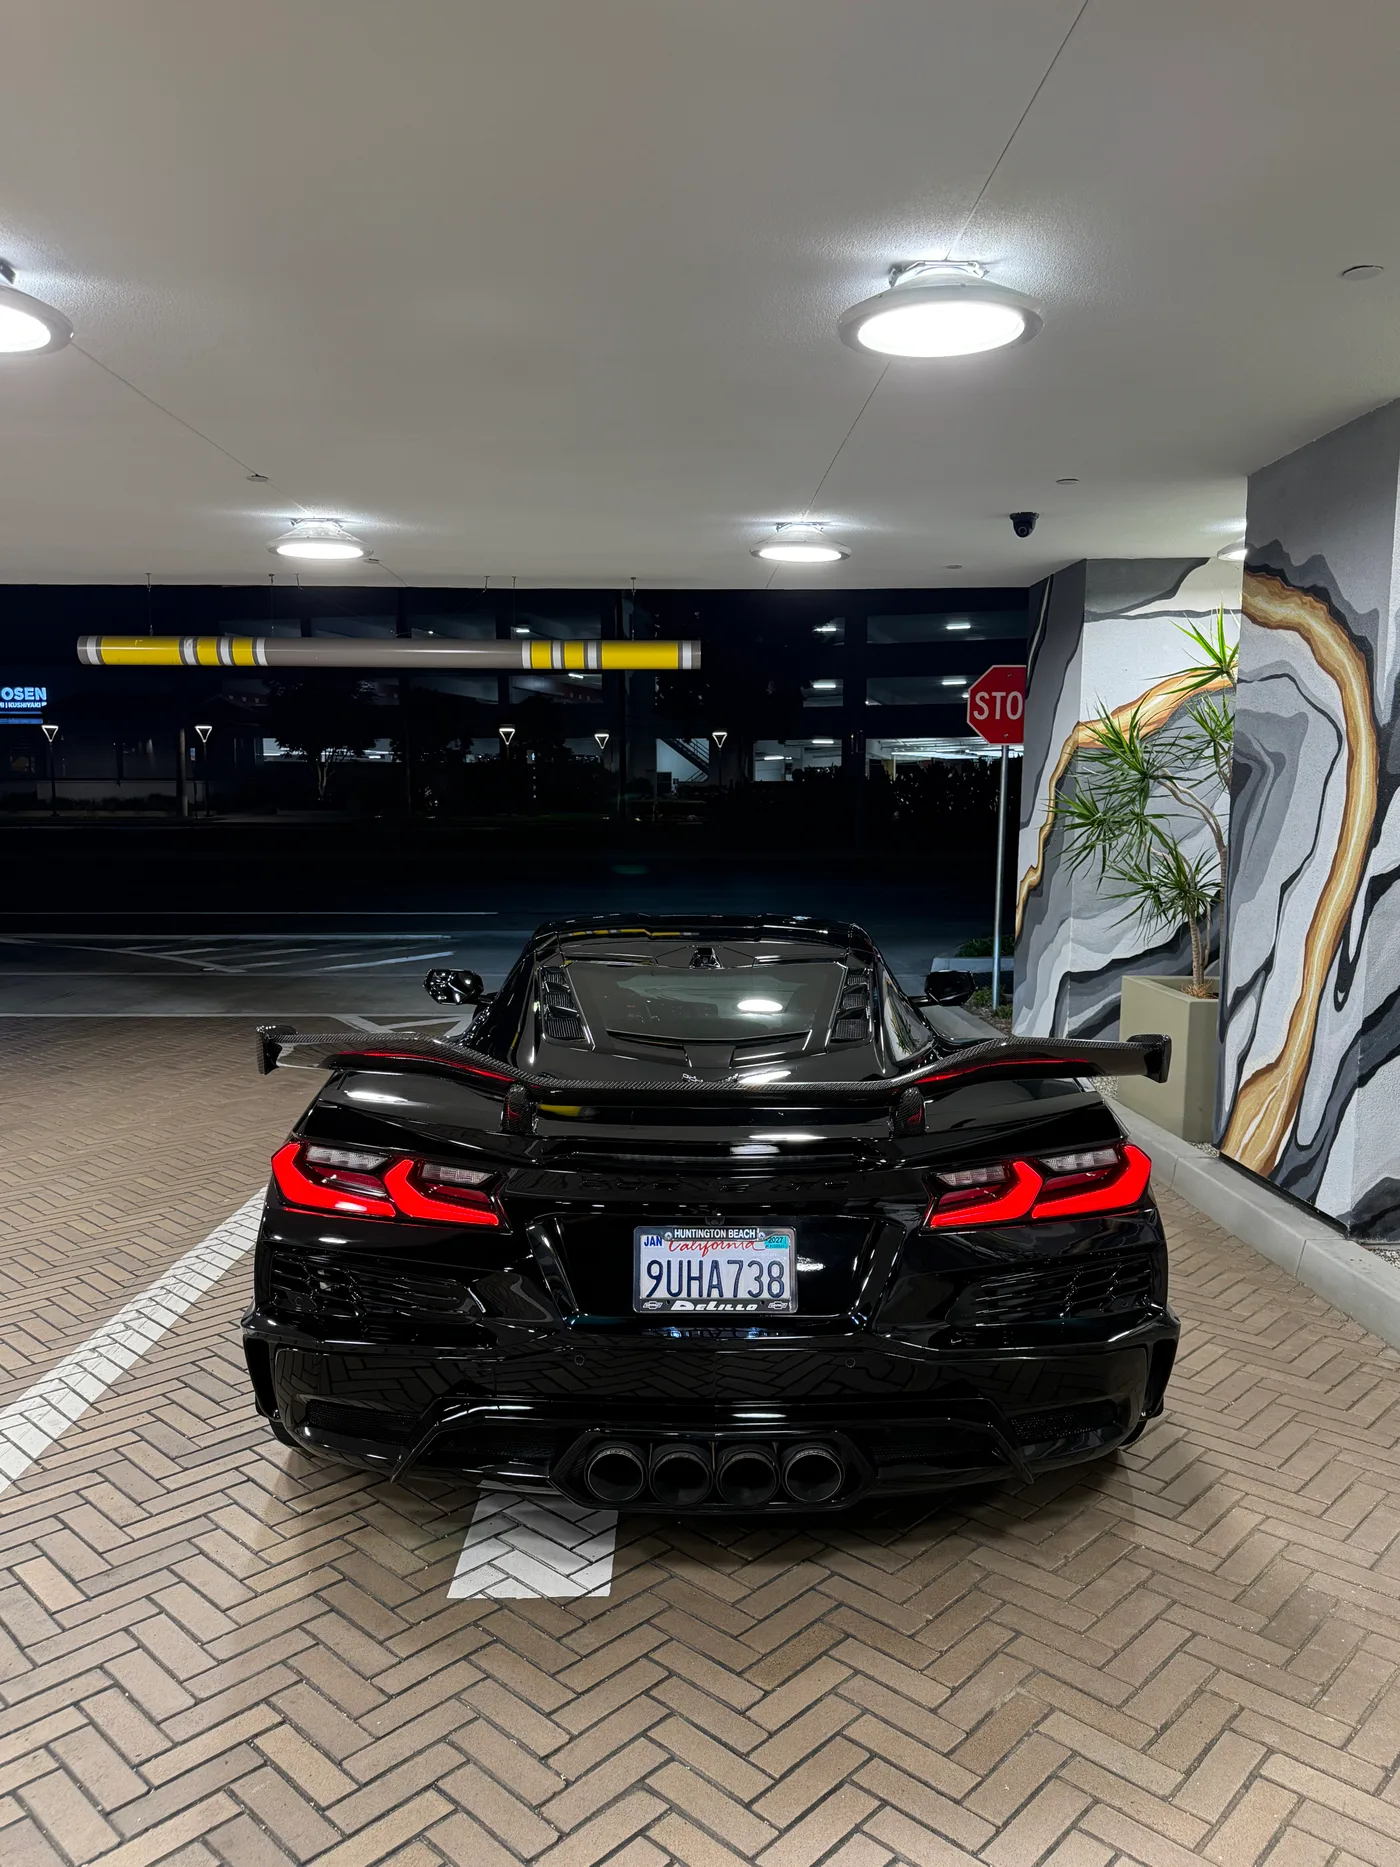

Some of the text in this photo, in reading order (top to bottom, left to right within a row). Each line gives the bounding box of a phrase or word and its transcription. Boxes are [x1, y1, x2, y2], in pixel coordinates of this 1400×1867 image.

[1, 687, 47, 701] OSEN
[973, 691, 1024, 721] STO
[674, 1229, 756, 1239] HUNTINGTON BEACH
[768, 1236, 784, 1244] 2027
[644, 1236, 663, 1247] JAN
[668, 1240, 767, 1258] California
[646, 1259, 785, 1299] 9UHA738
